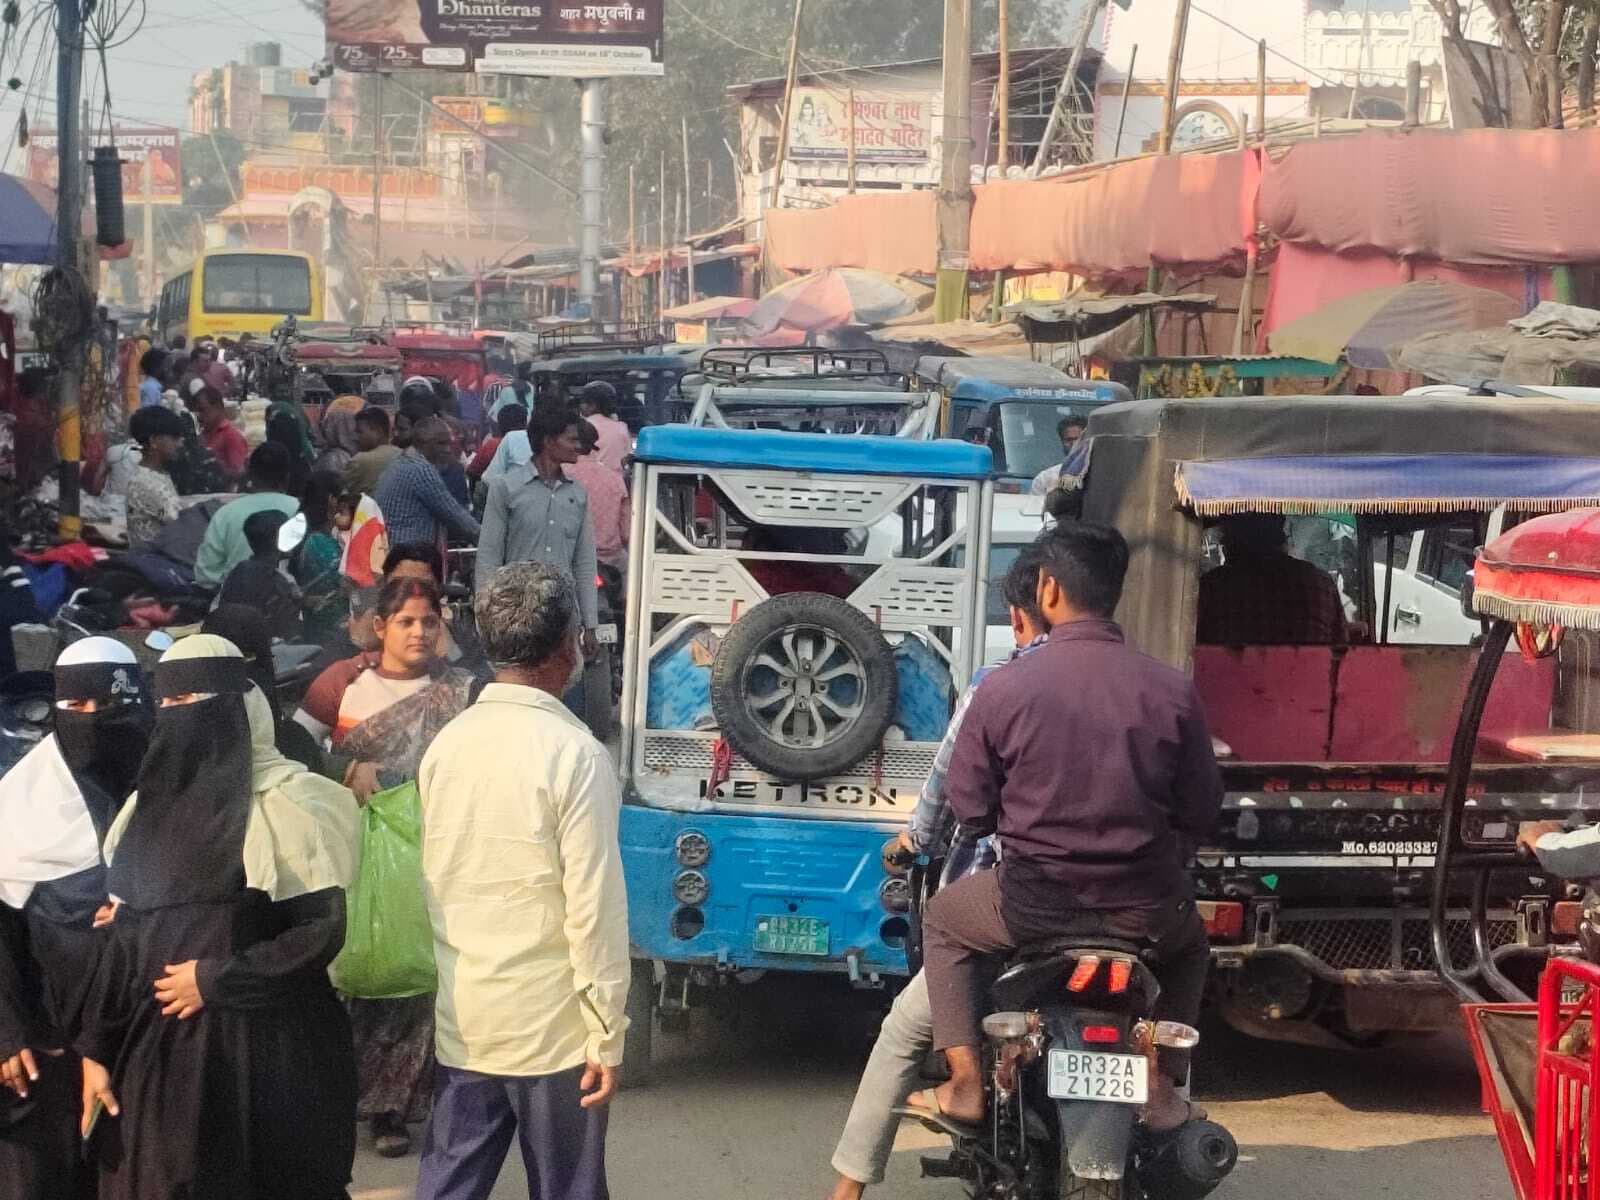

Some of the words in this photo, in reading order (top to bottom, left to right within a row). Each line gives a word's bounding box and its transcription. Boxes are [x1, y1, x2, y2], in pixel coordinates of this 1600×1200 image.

[437, 0, 542, 17] Dhanteras
[583, 3, 633, 25] मधुबनी
[699, 779, 897, 806] KETRON
[1067, 1054, 1134, 1076] BR32A
[1067, 1075, 1135, 1098] Z1226
